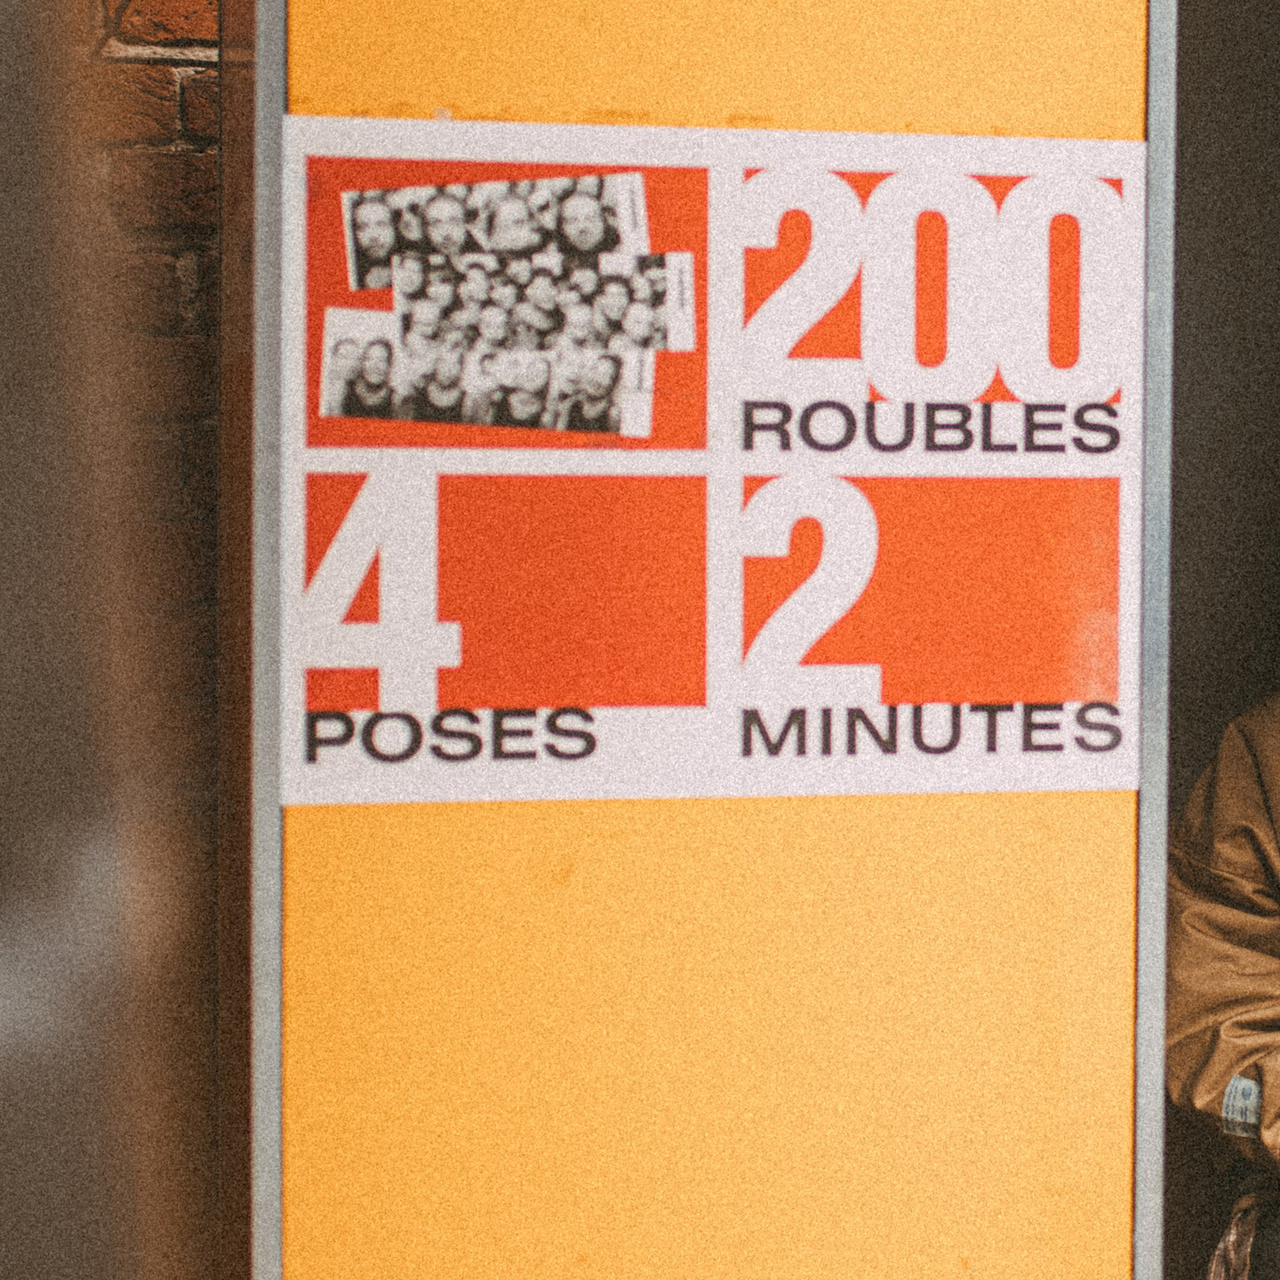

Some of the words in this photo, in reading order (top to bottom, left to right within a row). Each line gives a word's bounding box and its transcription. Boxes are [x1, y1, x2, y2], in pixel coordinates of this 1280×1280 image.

[741, 167, 1125, 404] 200
[743, 400, 1121, 454] ROUBLES
[303, 472, 462, 711] 4
[741, 475, 883, 705] 2
[304, 706, 597, 764] POSES
[742, 702, 1122, 757] MINUTES
